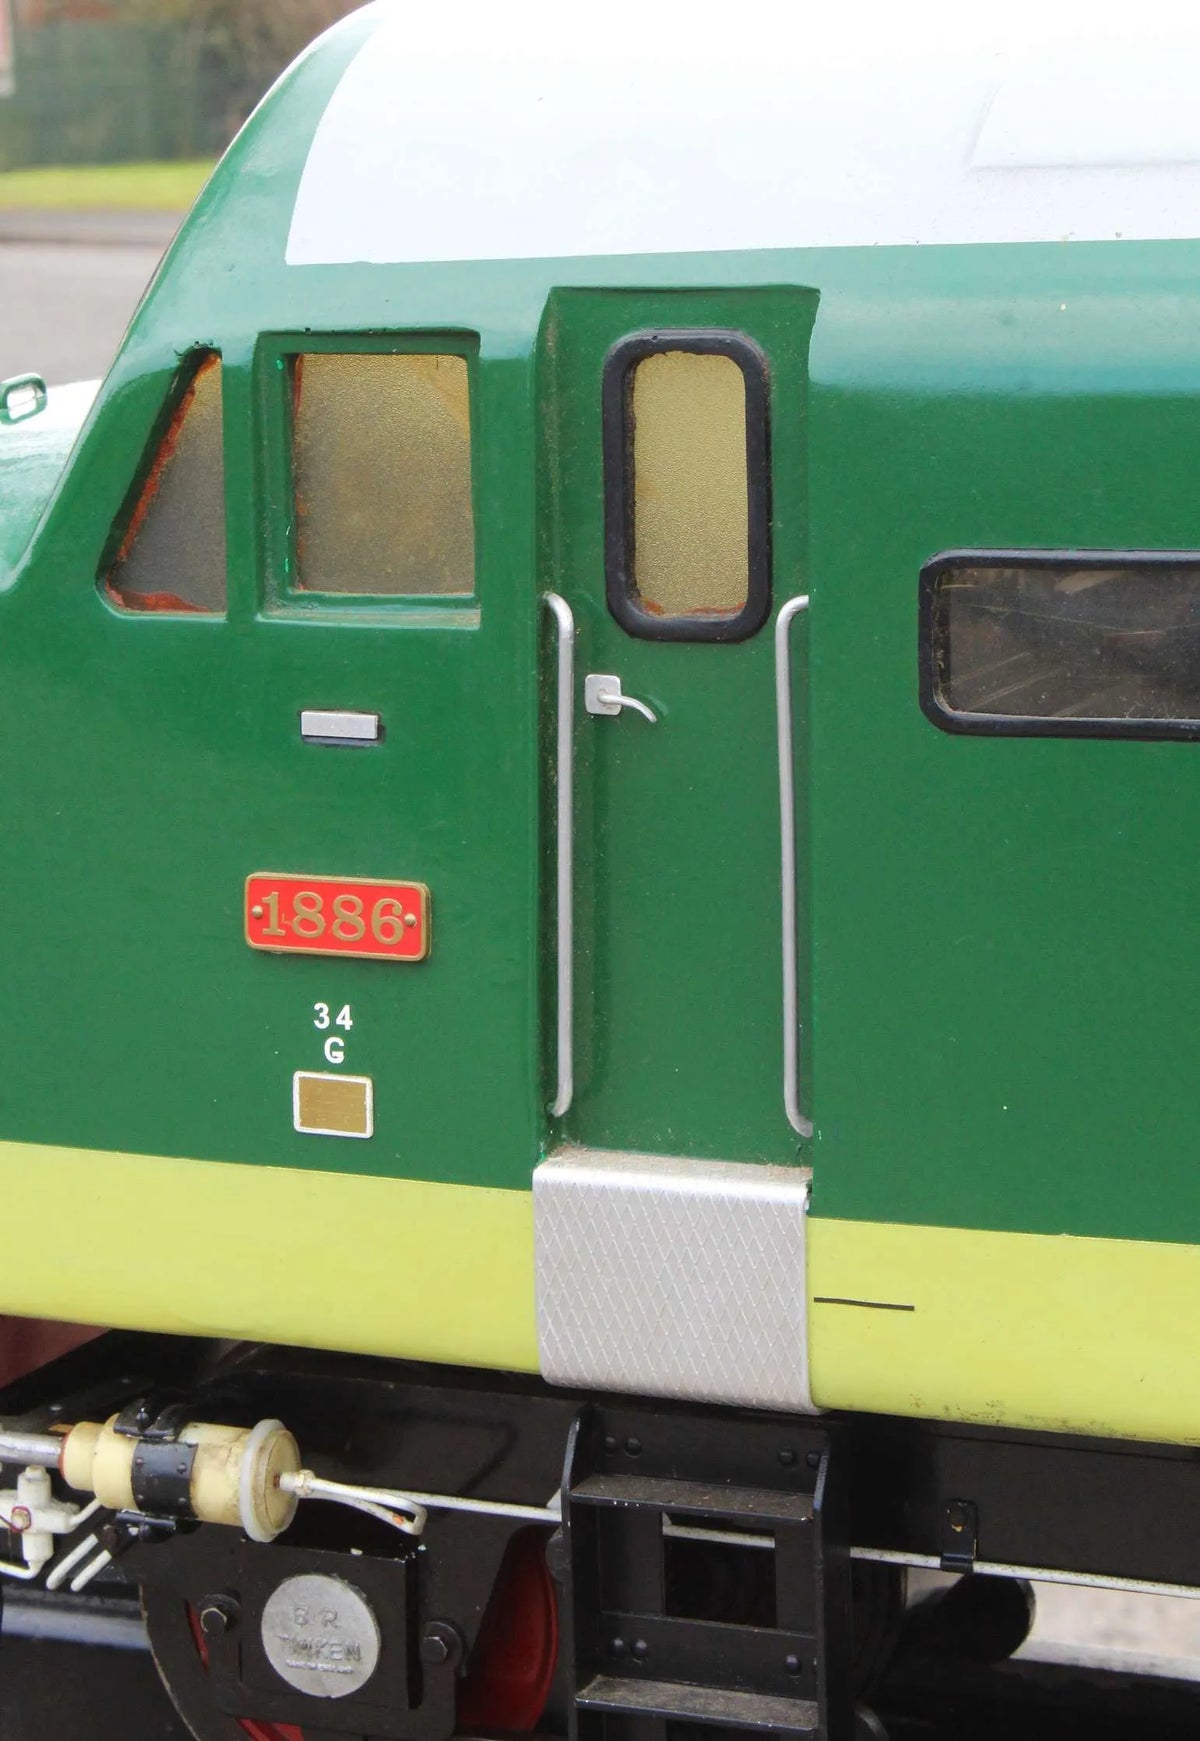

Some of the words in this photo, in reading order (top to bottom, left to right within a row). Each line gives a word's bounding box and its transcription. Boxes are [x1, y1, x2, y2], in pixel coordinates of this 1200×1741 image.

[261, 890, 405, 945] 1886
[313, 1002, 353, 1031] 34
[323, 1036, 345, 1064] G
